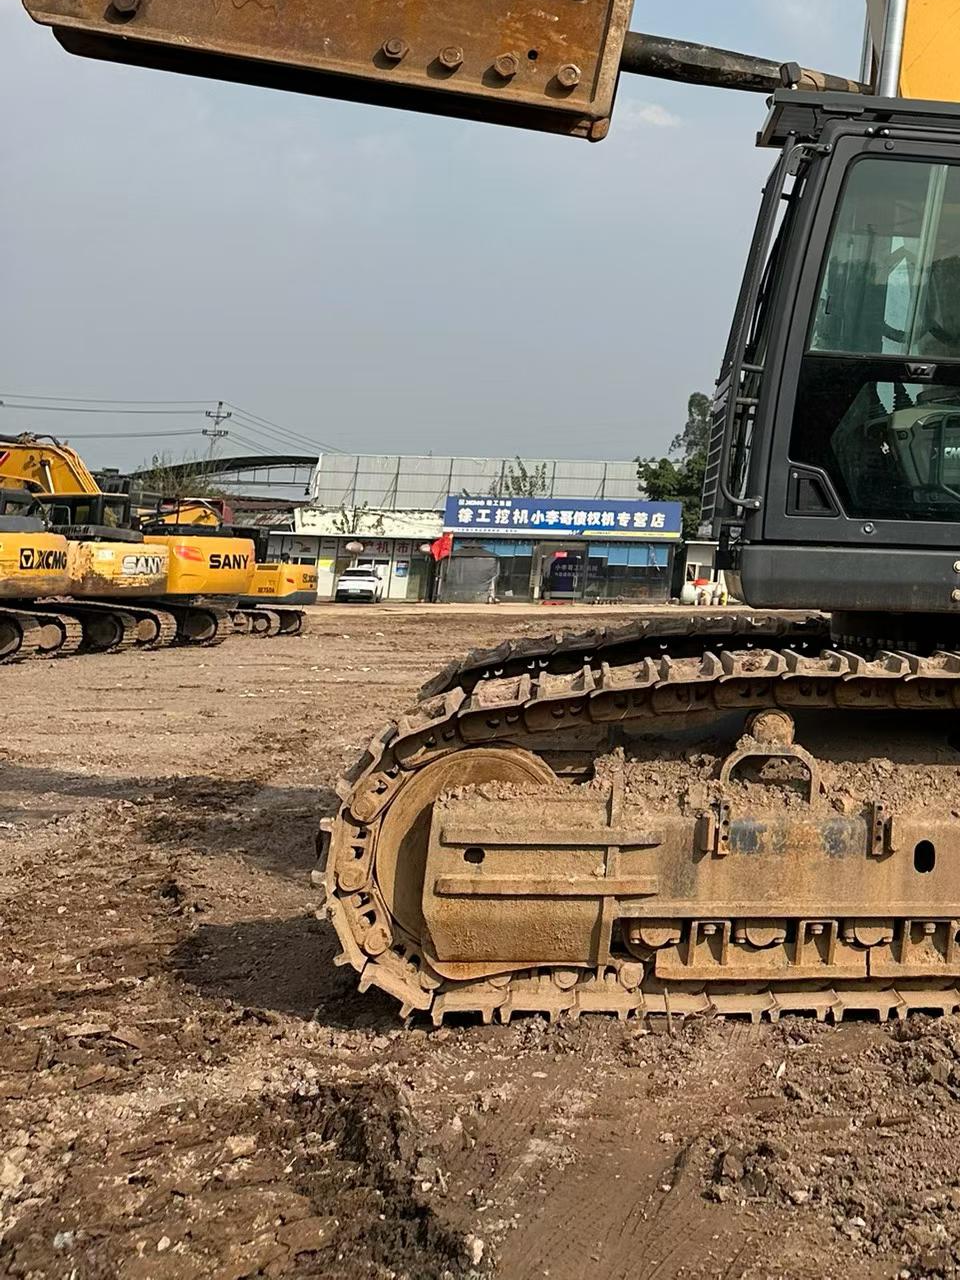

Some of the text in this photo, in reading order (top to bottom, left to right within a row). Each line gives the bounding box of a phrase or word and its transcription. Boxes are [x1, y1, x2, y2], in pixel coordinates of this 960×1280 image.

[34, 550, 67, 570] XCMG
[122, 555, 165, 576] SANY
[209, 553, 249, 570] SANY
